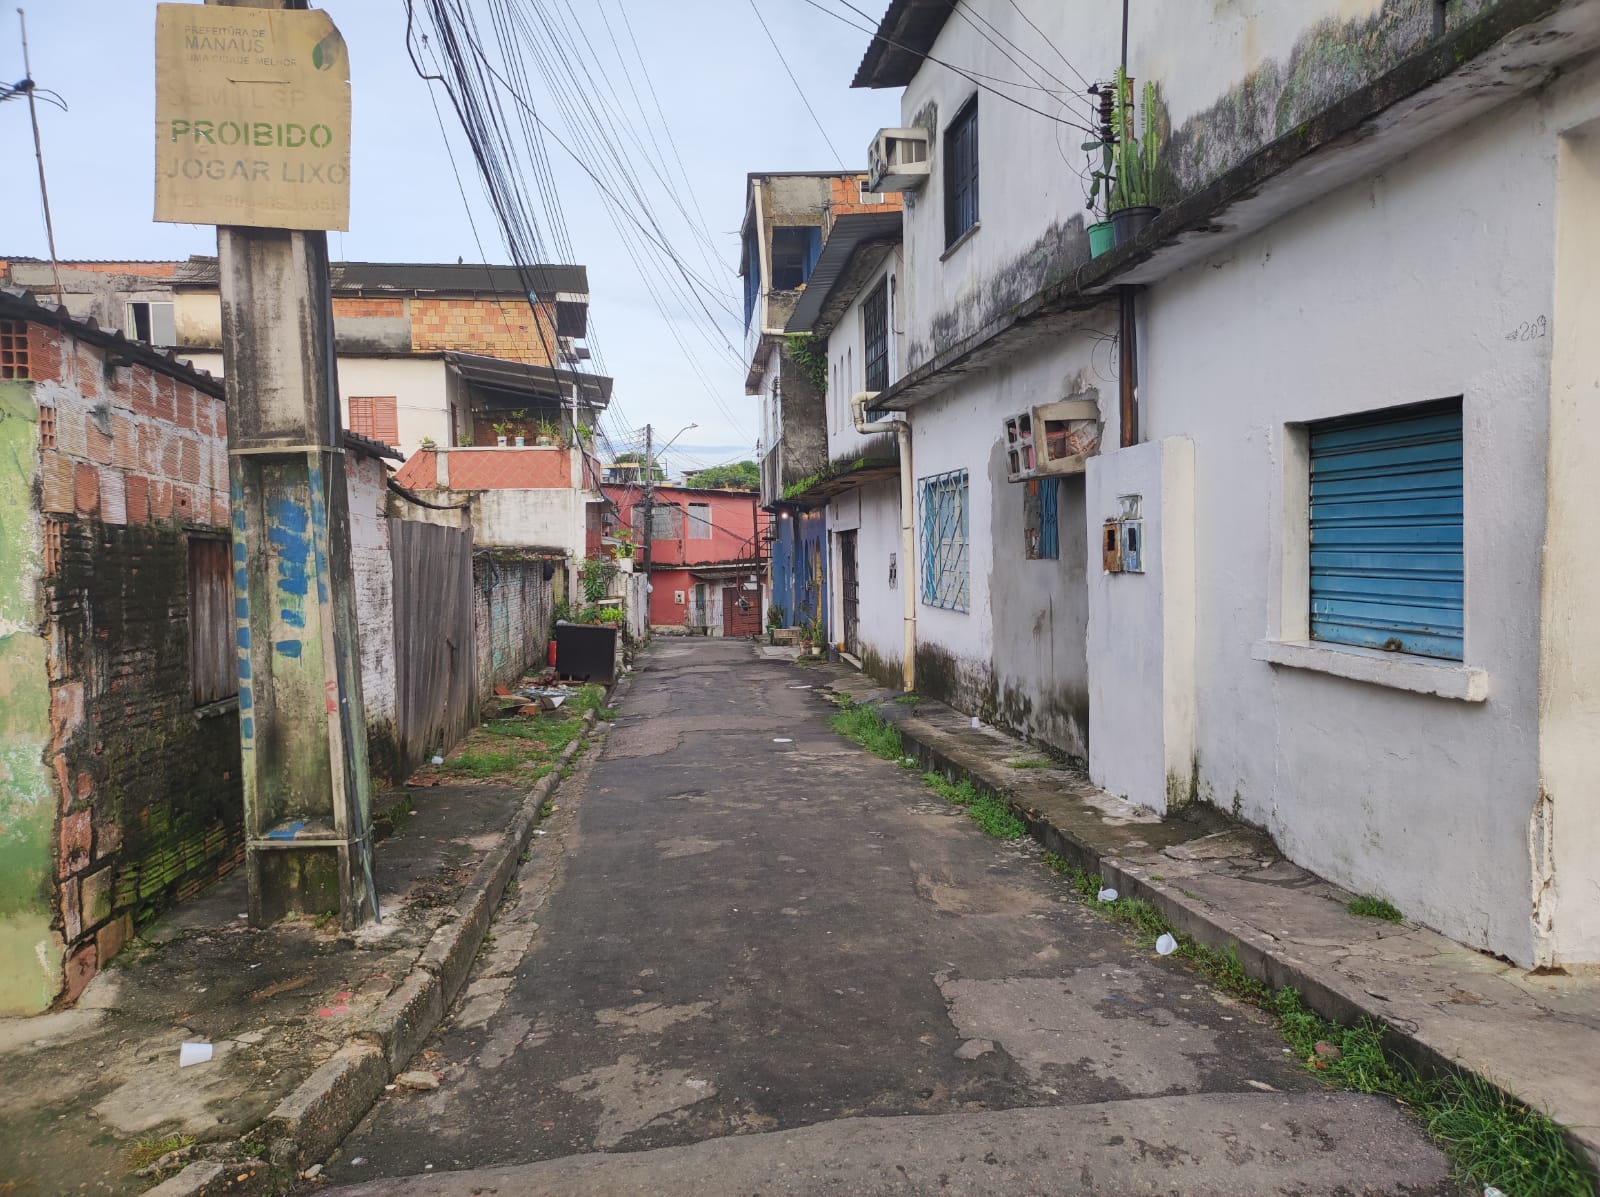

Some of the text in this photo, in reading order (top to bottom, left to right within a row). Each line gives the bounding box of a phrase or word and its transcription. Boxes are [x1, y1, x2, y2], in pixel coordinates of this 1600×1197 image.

[184, 35, 265, 54] MANAUS
[252, 28, 266, 38] DE
[171, 119, 333, 149] PROIBIDO
[165, 158, 347, 185] JOGAR LIXO
